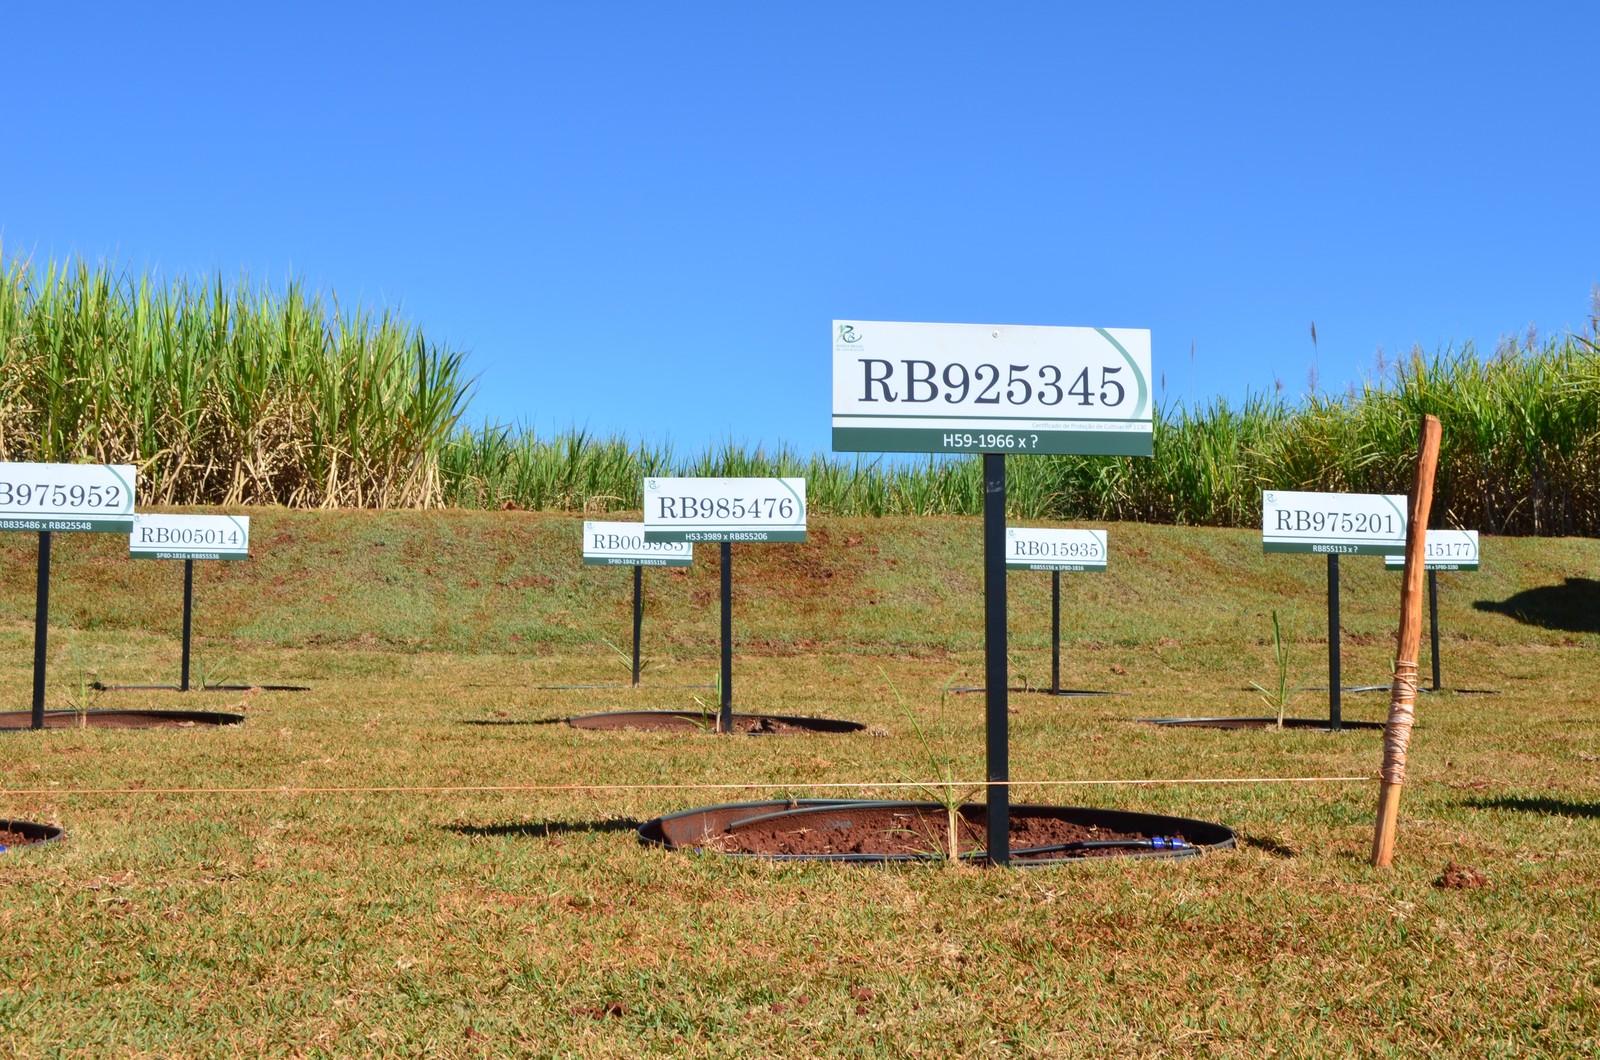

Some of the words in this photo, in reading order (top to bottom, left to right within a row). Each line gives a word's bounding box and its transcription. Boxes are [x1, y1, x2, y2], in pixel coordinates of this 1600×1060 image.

[858, 358, 1125, 407] RB925345
[943, 433, 1014, 449] H59-1966
[1018, 437, 1027, 449] x
[1031, 434, 1039, 449] ?
[657, 496, 794, 520] RB985476
[48, 521, 92, 530] RB825548
[1275, 509, 1395, 534] RB975201
[140, 526, 239, 545] RB005014
[685, 532, 722, 540] H53-3989
[729, 532, 768, 540] RB855206
[1014, 540, 1099, 557] RB015935
[1312, 544, 1347, 553] RB855113
[1353, 545, 1358, 553] ?
[1424, 543, 1471, 557] 15177
